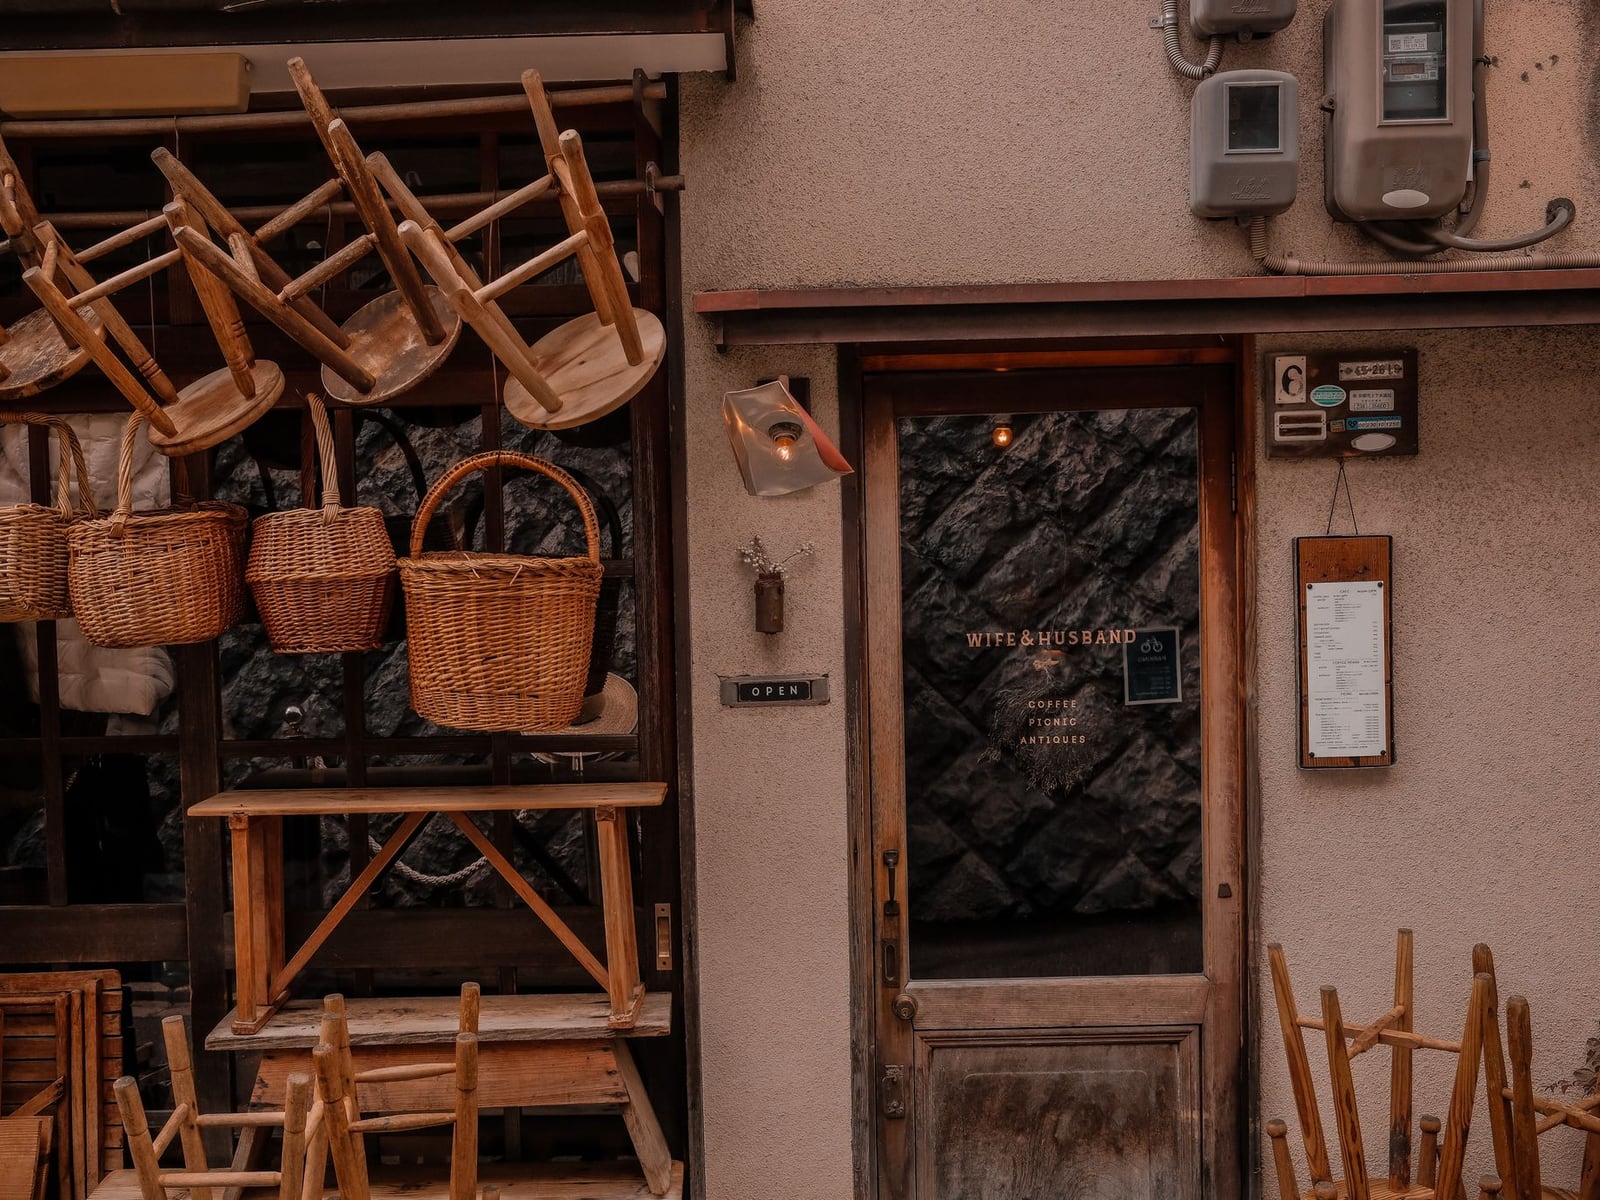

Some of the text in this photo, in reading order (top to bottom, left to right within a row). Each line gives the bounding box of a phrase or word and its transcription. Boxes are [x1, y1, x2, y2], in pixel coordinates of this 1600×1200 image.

[966, 629, 1137, 648] WIFE&HUSBAND
[751, 685, 798, 696] OPEN
[1028, 699, 1078, 710] COFFEE
[1028, 717, 1078, 727] PICNIC
[1019, 734, 1087, 745] ANTIQUES
